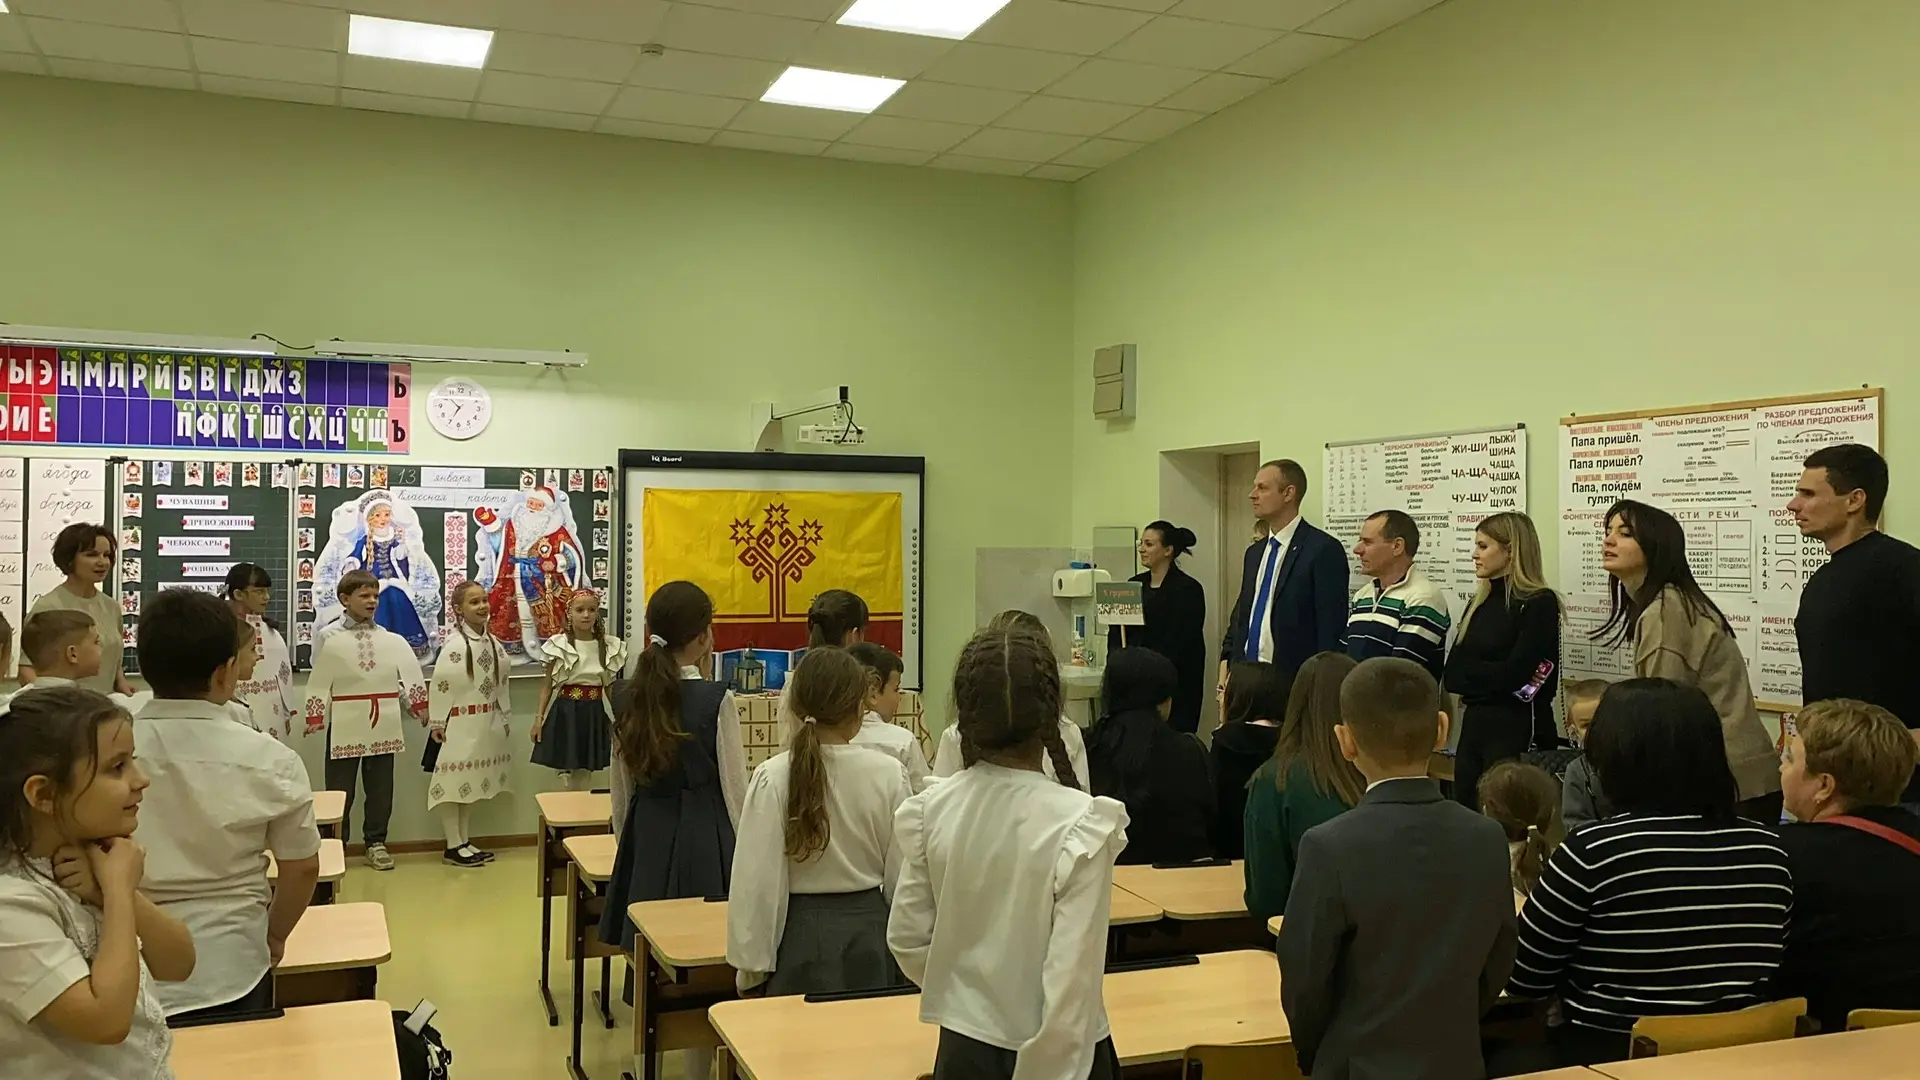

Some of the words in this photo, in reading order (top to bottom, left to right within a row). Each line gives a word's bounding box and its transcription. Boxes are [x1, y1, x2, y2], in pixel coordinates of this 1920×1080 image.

[1765, 410, 1796, 419] РАЗБОР
[1798, 404, 1866, 416] ПРЕДЛОЖЕНИЯ
[1655, 419, 1684, 427] ЧЛЕНЫ
[1685, 413, 1749, 425] ПРЕДЛОЖЕНИЯ
[1757, 421, 1769, 429] ПО
[1771, 418, 1805, 428] ЧЛЕНАМ
[1806, 413, 1874, 426] ПРЕДЛОЖЕНИЯ
[1489, 434, 1516, 444] ЛЫЖИ
[1571, 436, 1595, 447] Папа
[1598, 432, 1642, 447] пришёл.
[1489, 447, 1516, 456] ШИНА
[1489, 460, 1515, 469] ЧАЩА
[1569, 459, 1594, 469] Папа
[1596, 455, 1643, 470] пришёл?
[1489, 471, 1520, 481] ЧАШКА
[1490, 485, 1517, 495] ЧУЛОК
[1572, 482, 1599, 494] Папа,
[1601, 480, 1641, 492] пойдём
[1490, 498, 1516, 508] ЩУКА
[1768, 509, 1795, 517] ПОРЯ
[1802, 547, 1832, 556] ОСНО
[1761, 616, 1785, 624] ИМЕН
